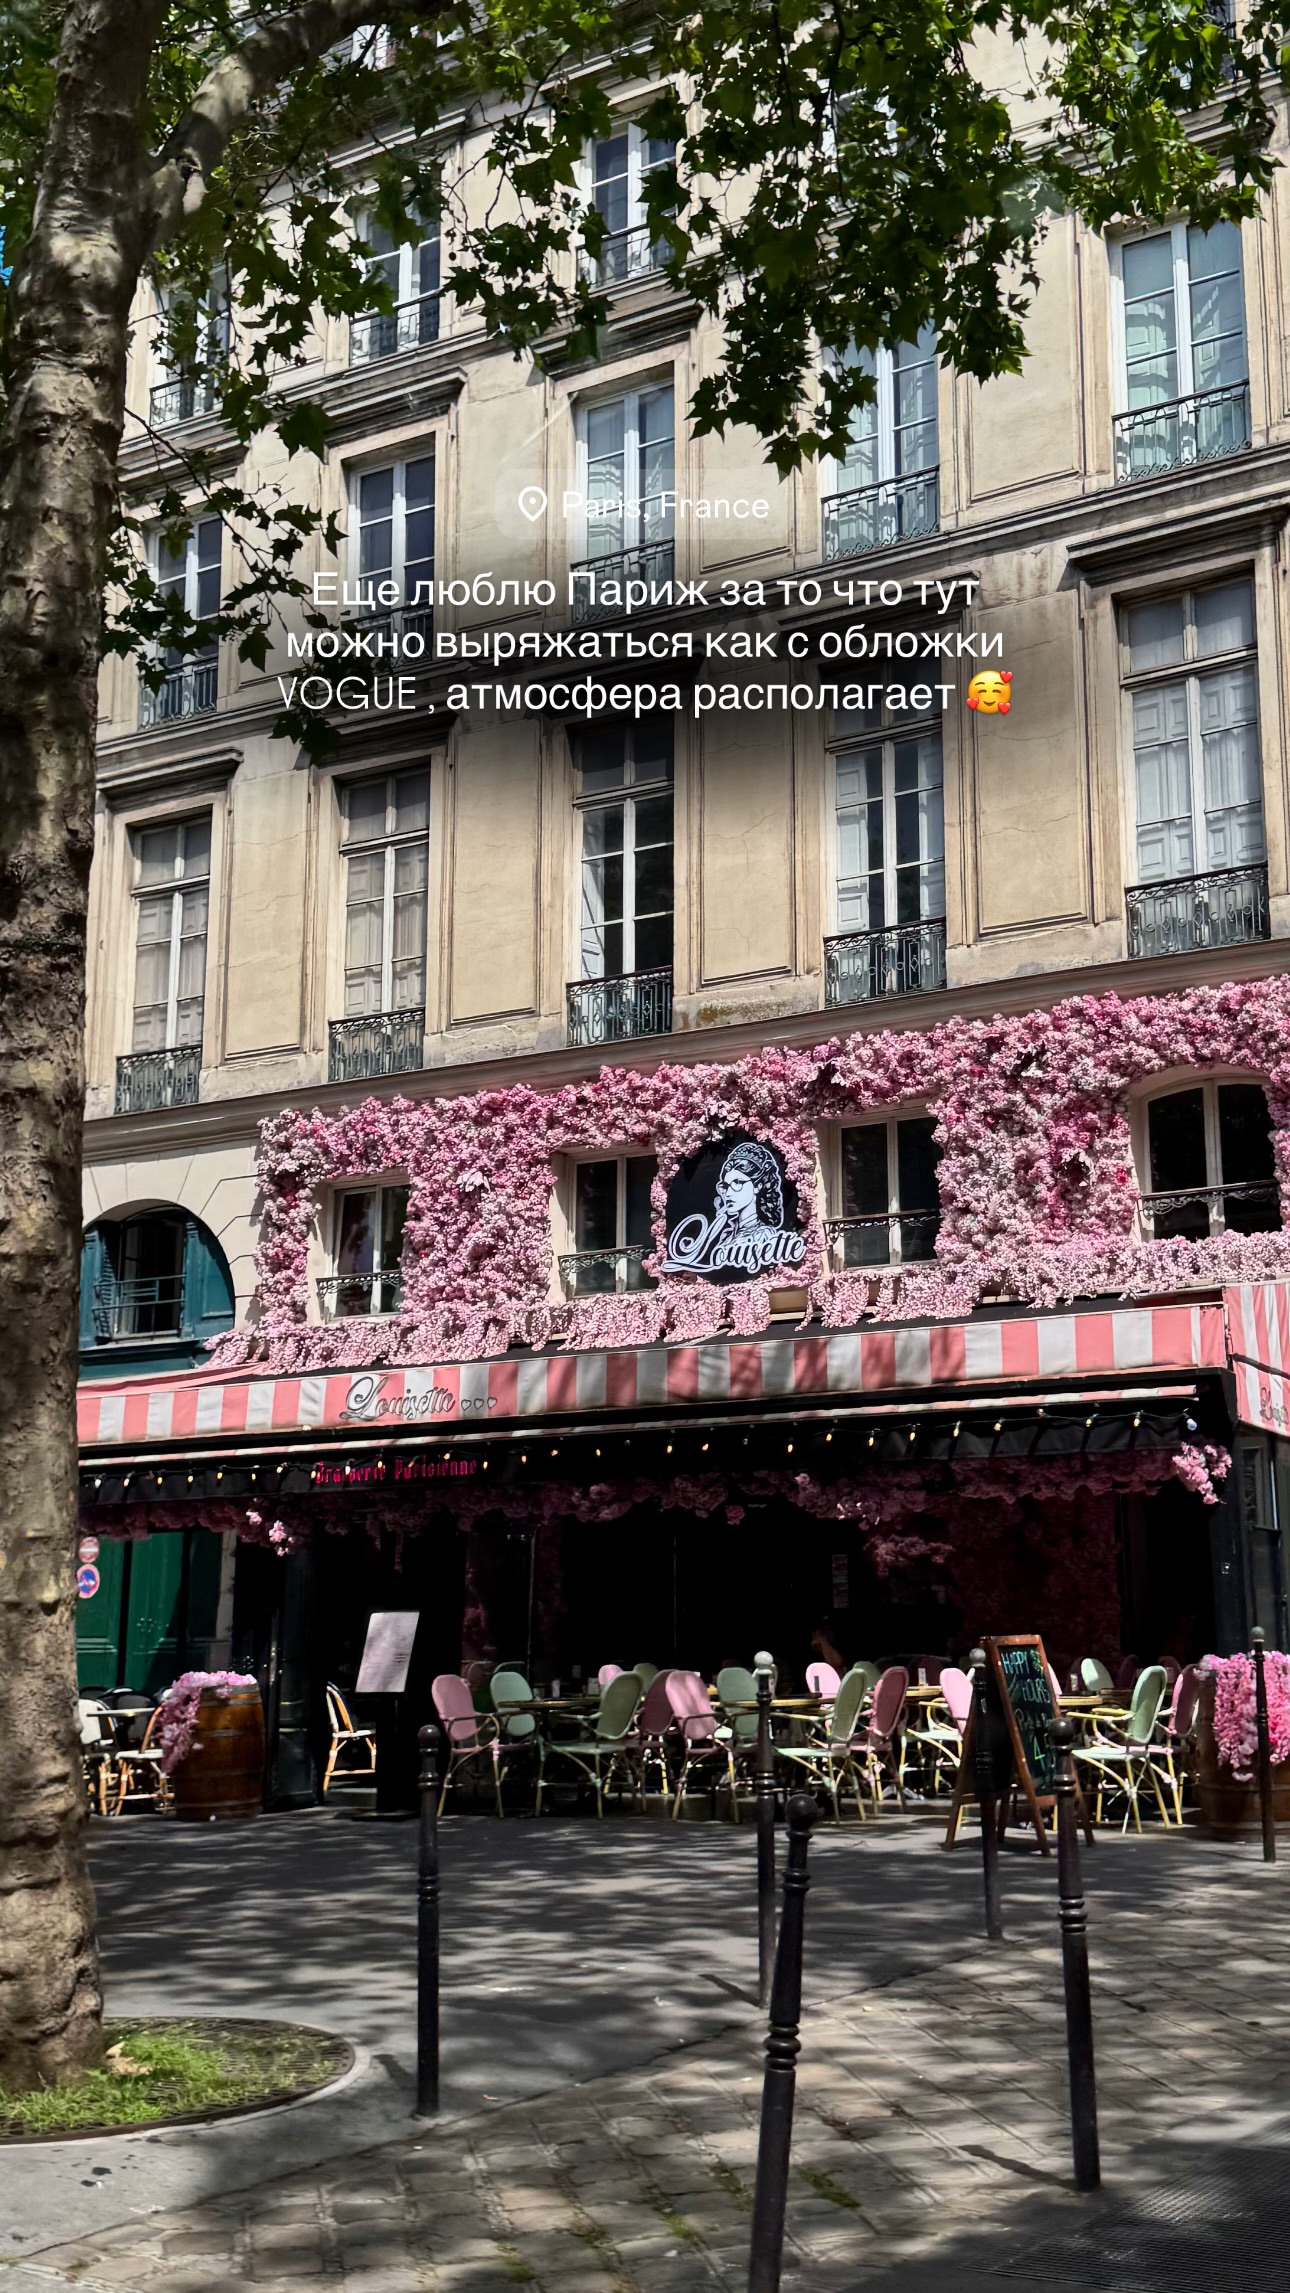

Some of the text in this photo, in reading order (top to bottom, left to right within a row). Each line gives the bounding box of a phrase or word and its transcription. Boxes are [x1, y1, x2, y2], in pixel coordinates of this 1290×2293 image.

[660, 1213, 807, 1274] Louisette
[339, 1375, 456, 1421] Louisette
[1001, 1650, 1030, 1675] HAPPY
